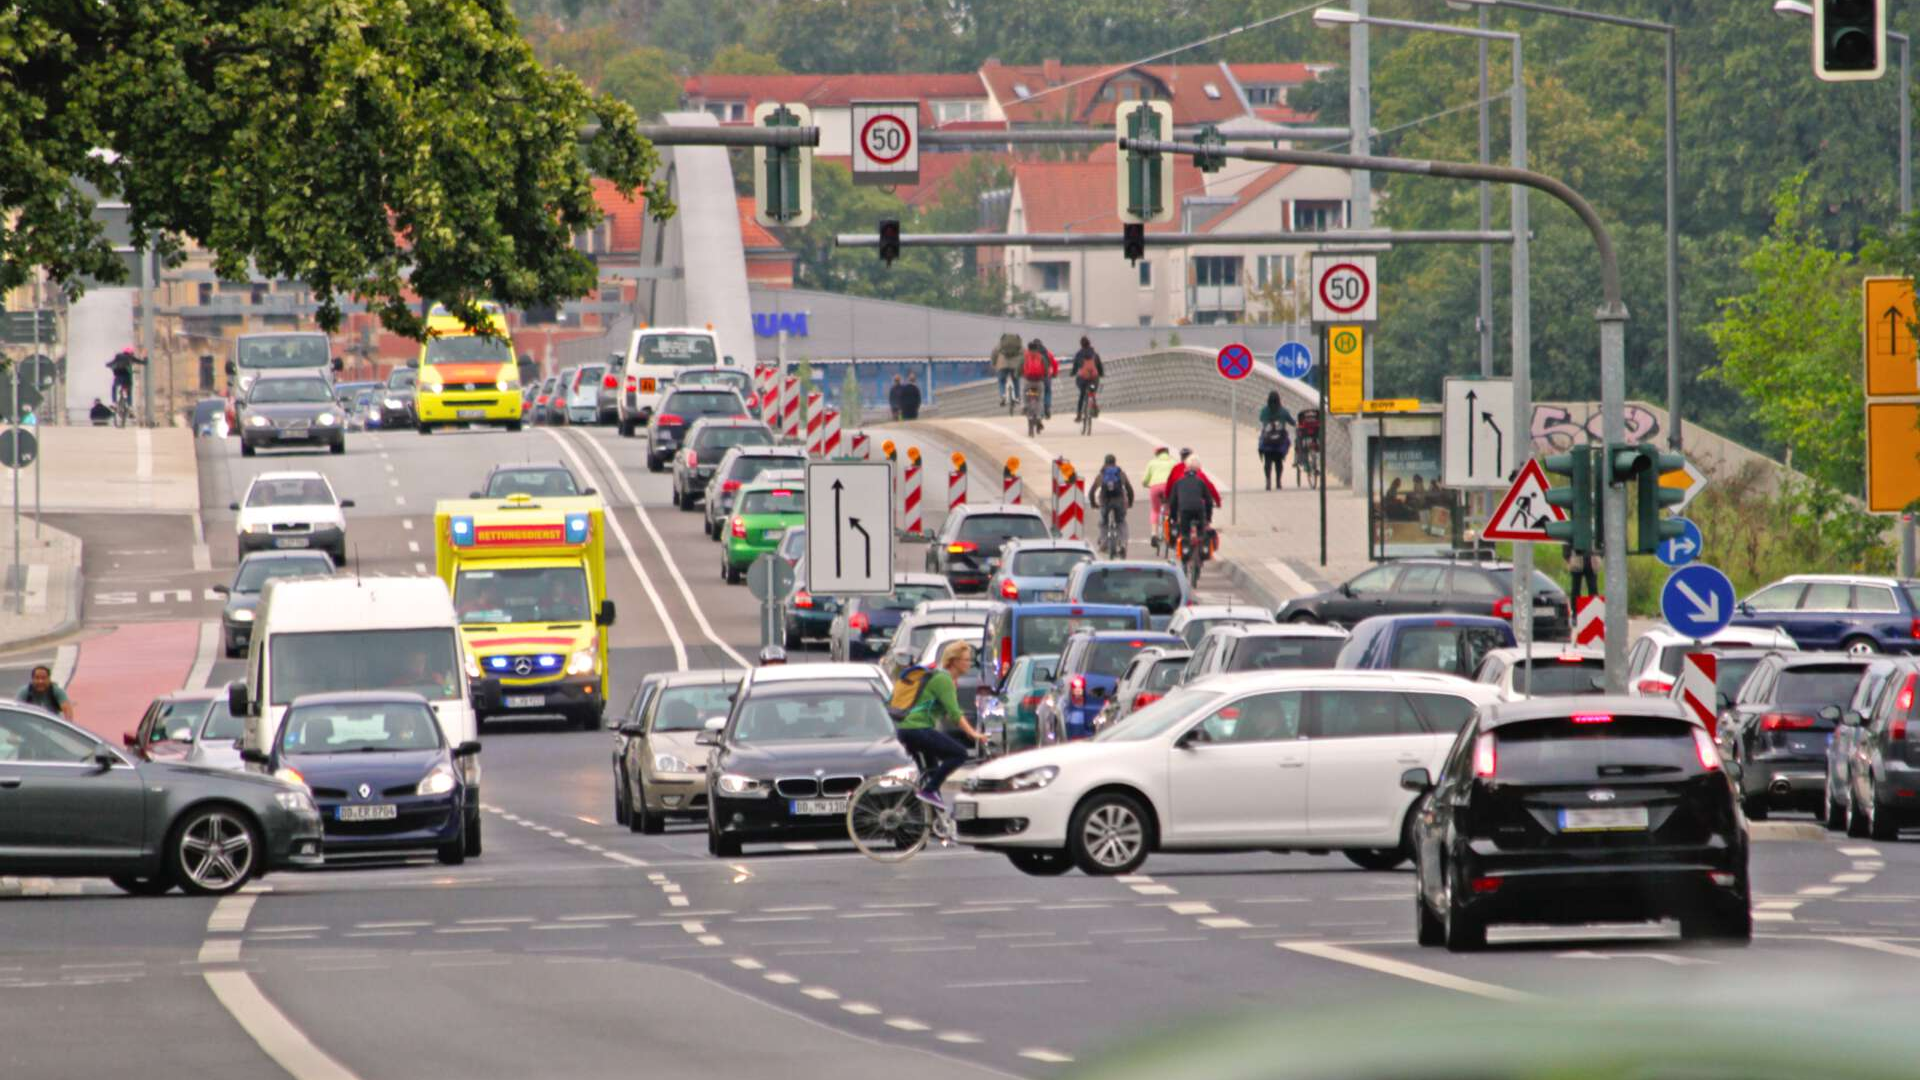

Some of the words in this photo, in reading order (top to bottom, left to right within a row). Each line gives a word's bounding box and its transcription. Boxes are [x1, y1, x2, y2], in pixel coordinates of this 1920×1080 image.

[872, 128, 900, 151] 50
[1331, 277, 1359, 300] 50
[752, 313, 808, 338] UM
[478, 530, 561, 541] RETTUNGSDIENST
